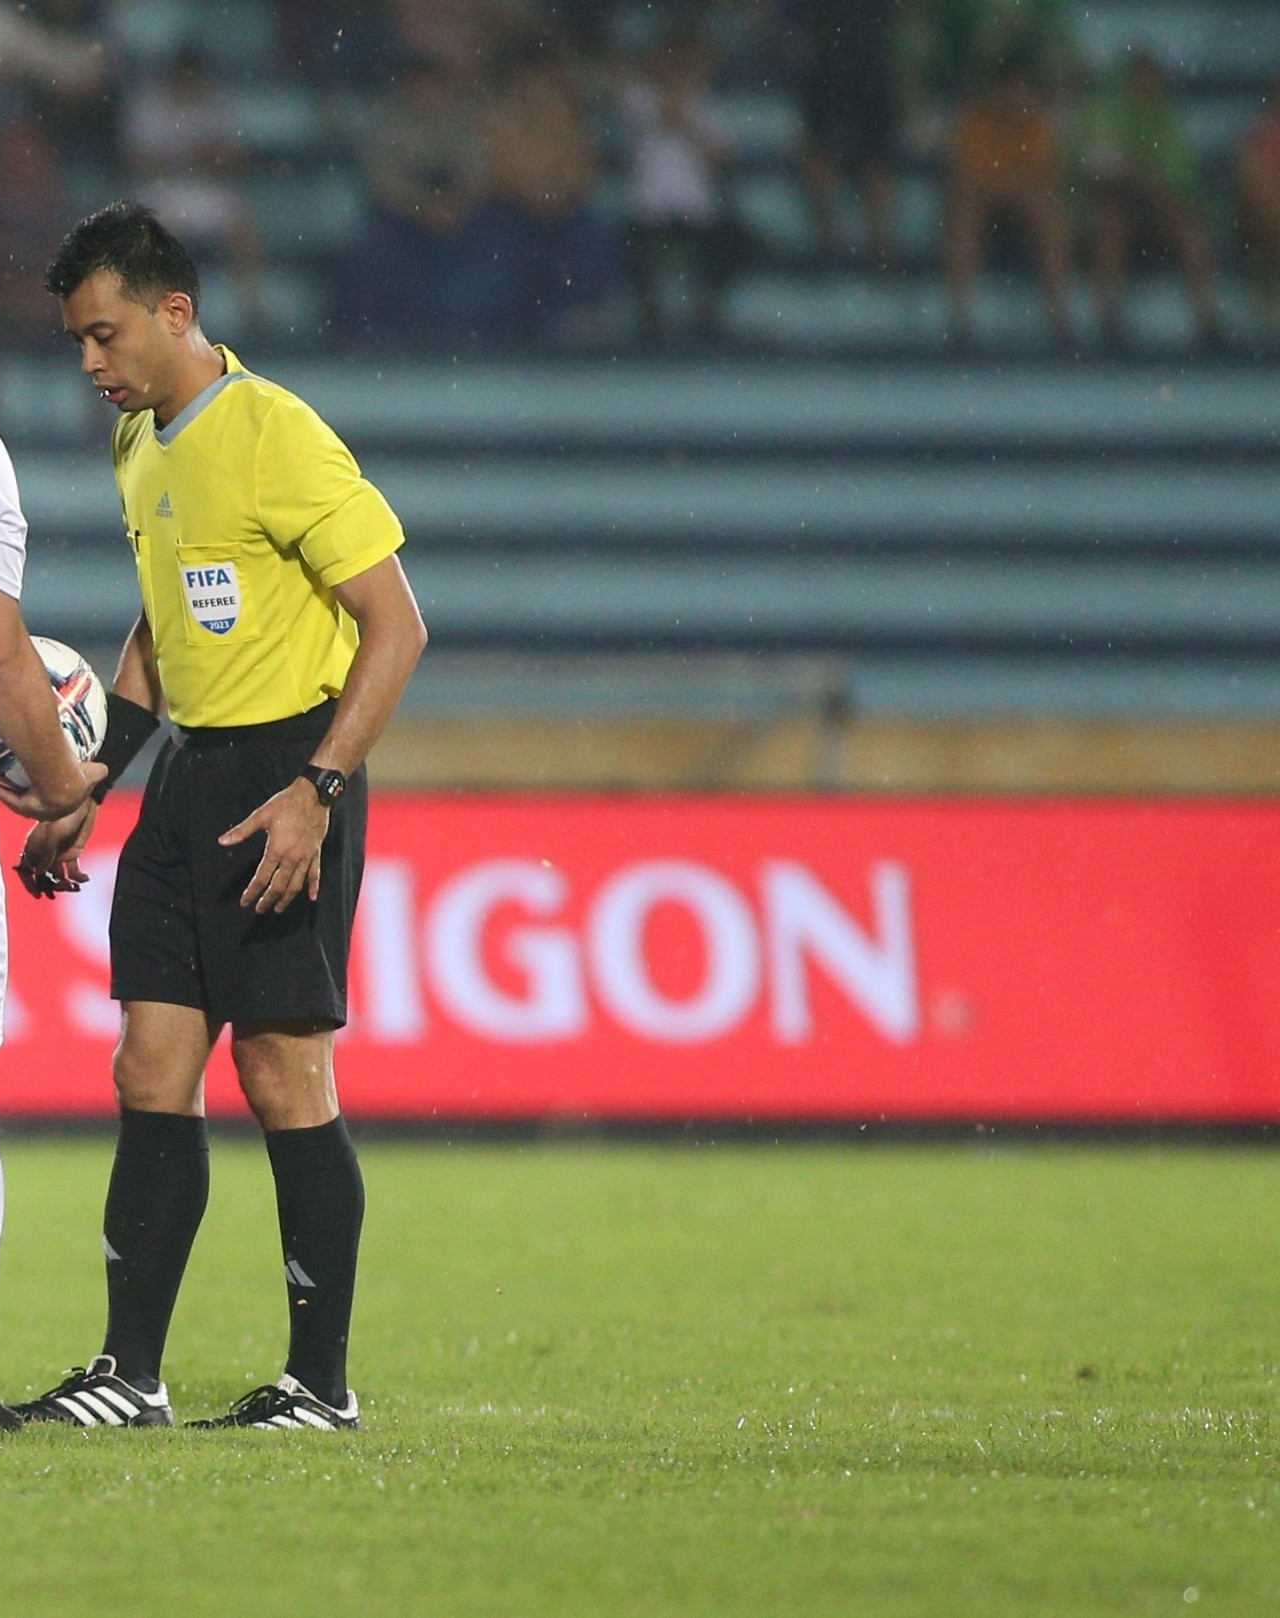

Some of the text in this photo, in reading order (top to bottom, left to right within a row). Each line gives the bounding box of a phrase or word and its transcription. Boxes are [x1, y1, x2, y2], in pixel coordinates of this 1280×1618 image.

[185, 568, 232, 588] FIFA
[192, 595, 237, 609] REFEREE
[208, 621, 230, 630] 2023
